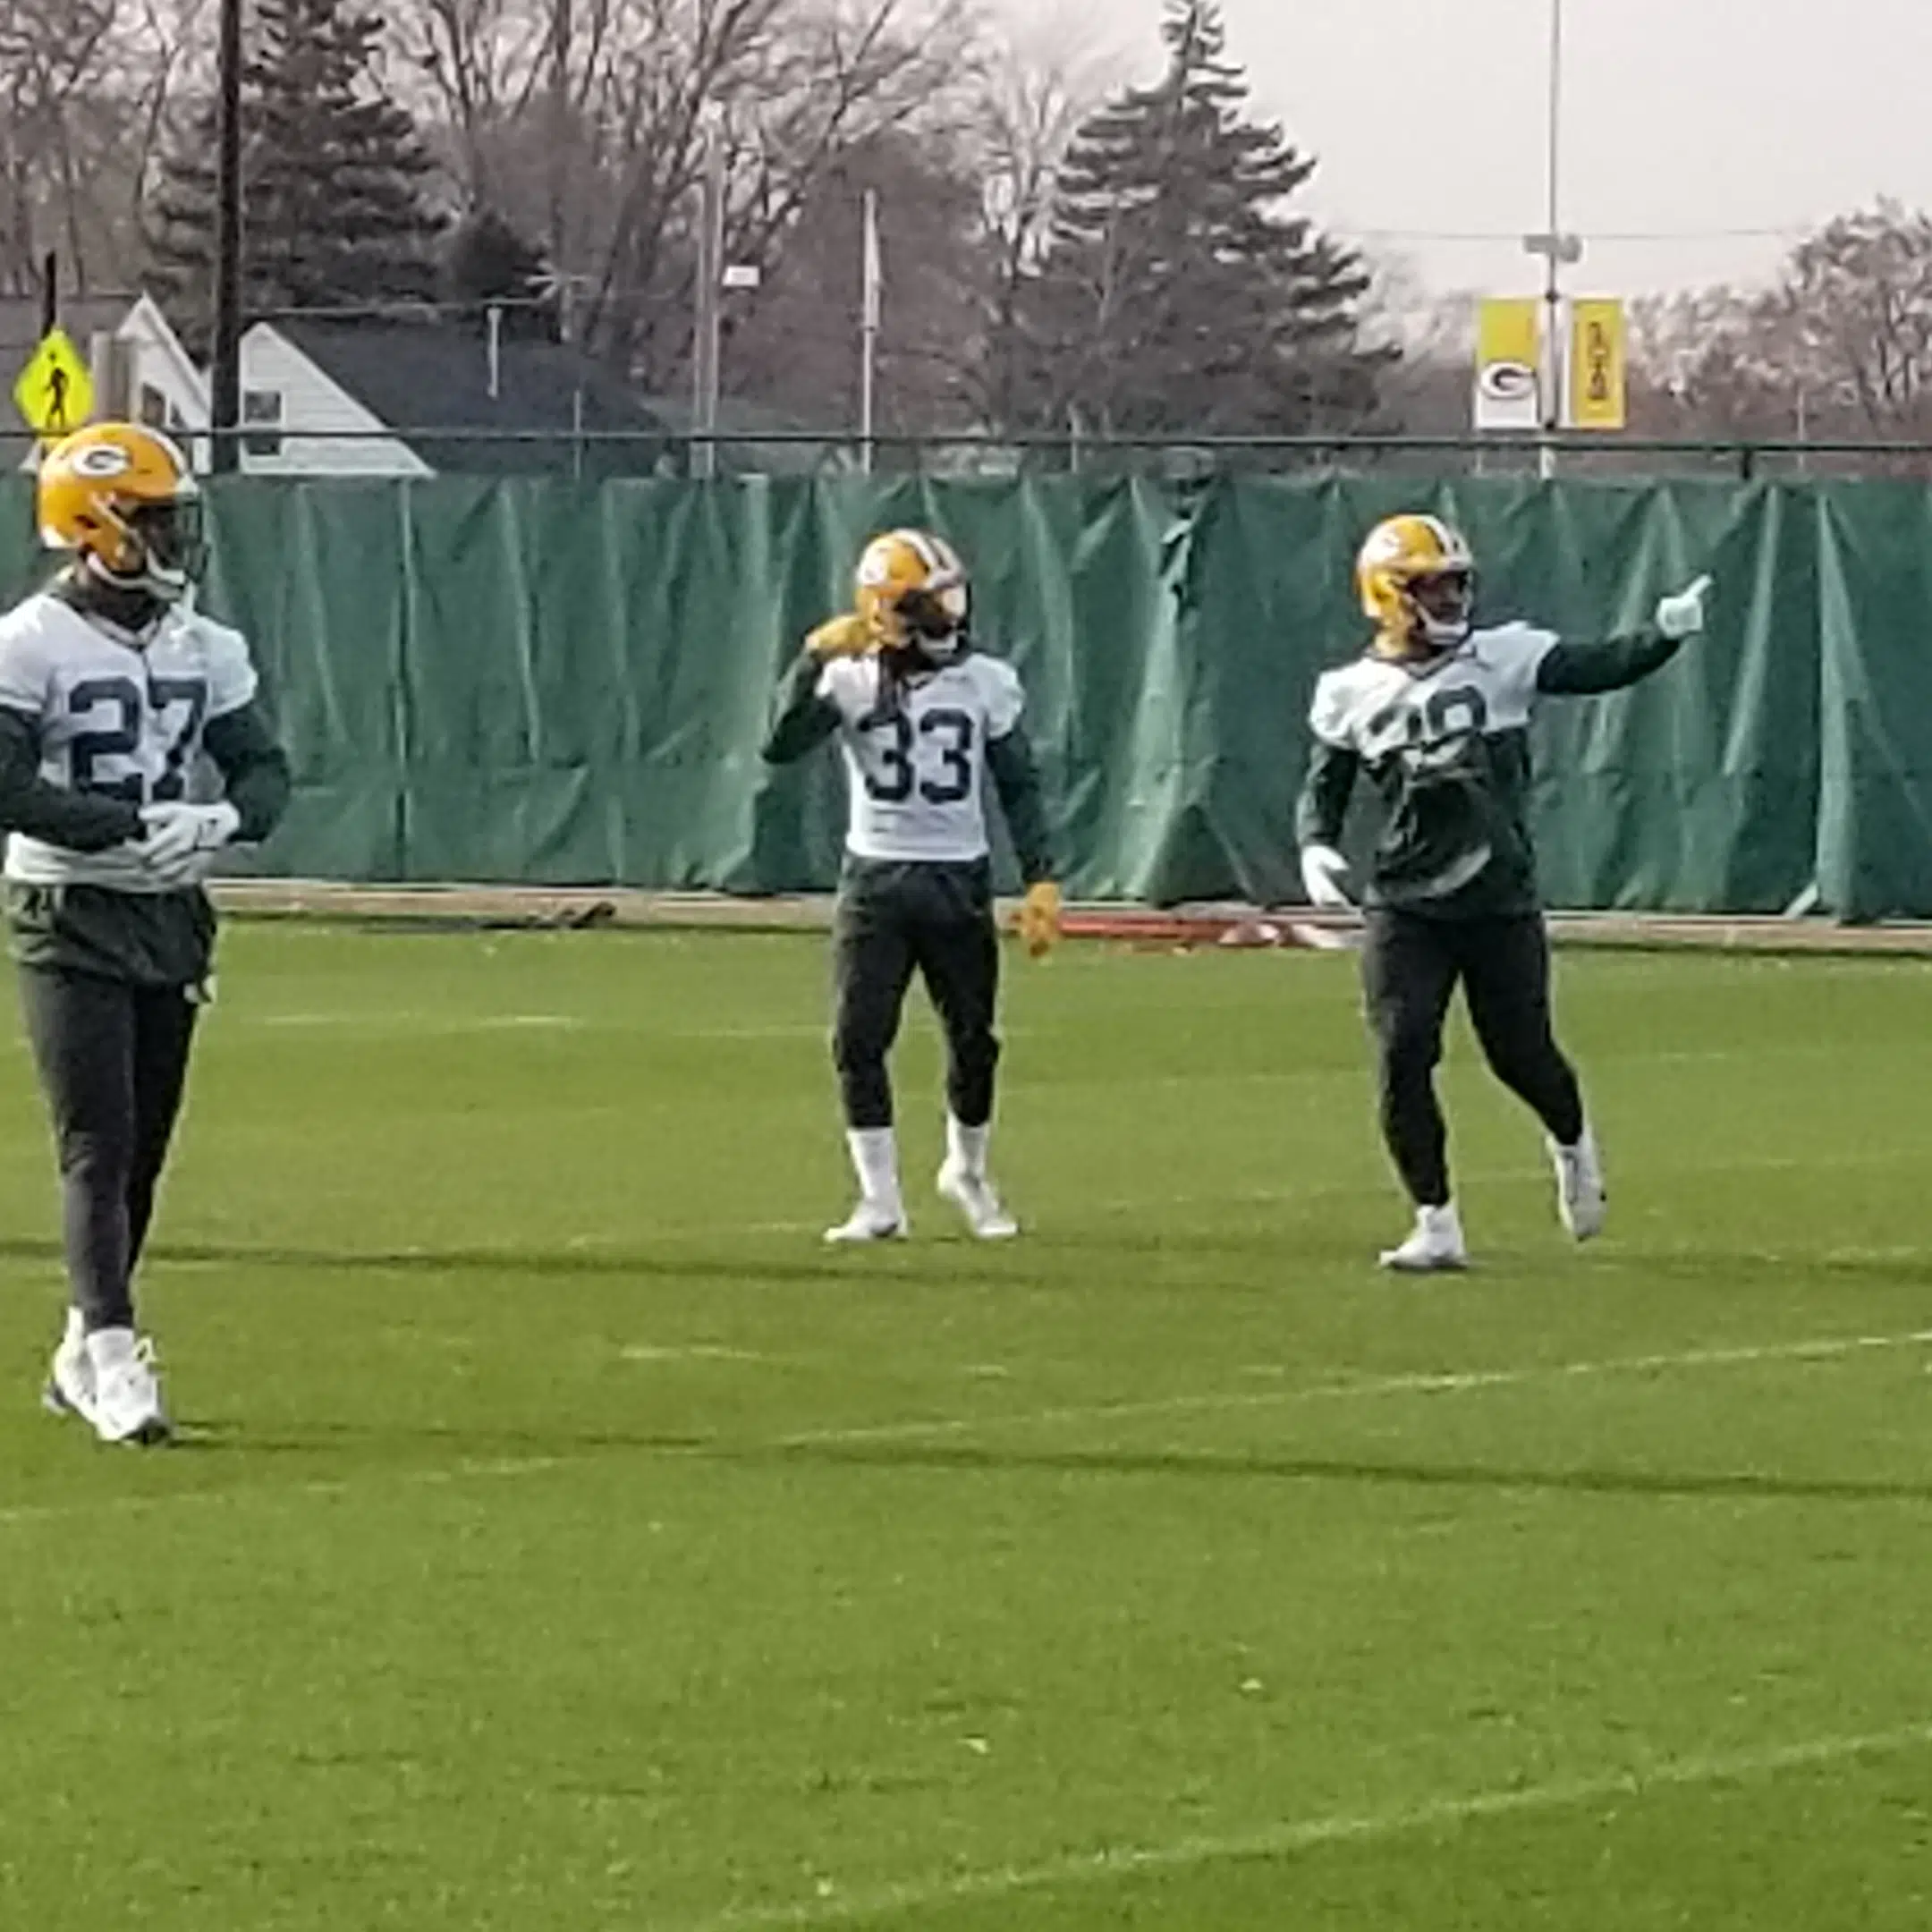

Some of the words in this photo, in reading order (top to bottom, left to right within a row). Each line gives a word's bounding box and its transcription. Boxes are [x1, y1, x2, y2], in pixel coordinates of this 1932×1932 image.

[1490, 365, 1537, 393] G
[81, 447, 131, 472] G
[70, 676, 206, 801] 27
[858, 708, 972, 804] 33
